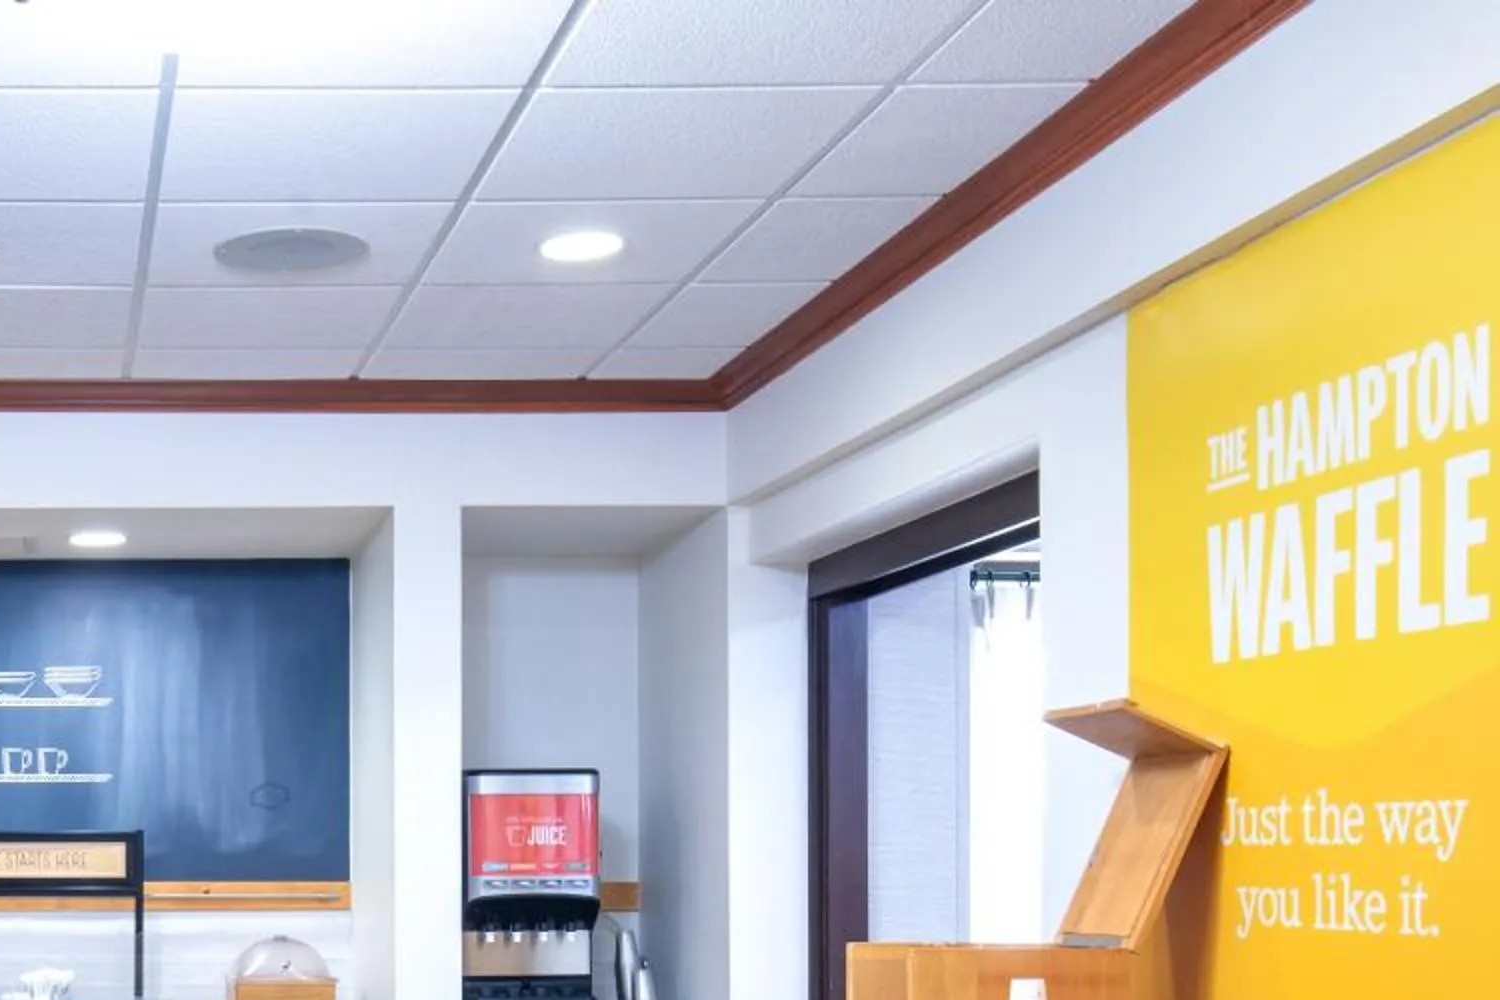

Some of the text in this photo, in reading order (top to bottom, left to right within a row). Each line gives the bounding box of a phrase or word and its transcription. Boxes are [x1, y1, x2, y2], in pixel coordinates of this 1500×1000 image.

[1206, 322, 1490, 490] THE HAMPTON
[1206, 448, 1491, 665] WAFFLE
[4, 850, 51, 869] STARTS
[55, 850, 88, 869] HERE
[527, 825, 567, 847] JUICE
[1221, 786, 1469, 863] Just the way
[1236, 872, 1440, 940] you like it.
